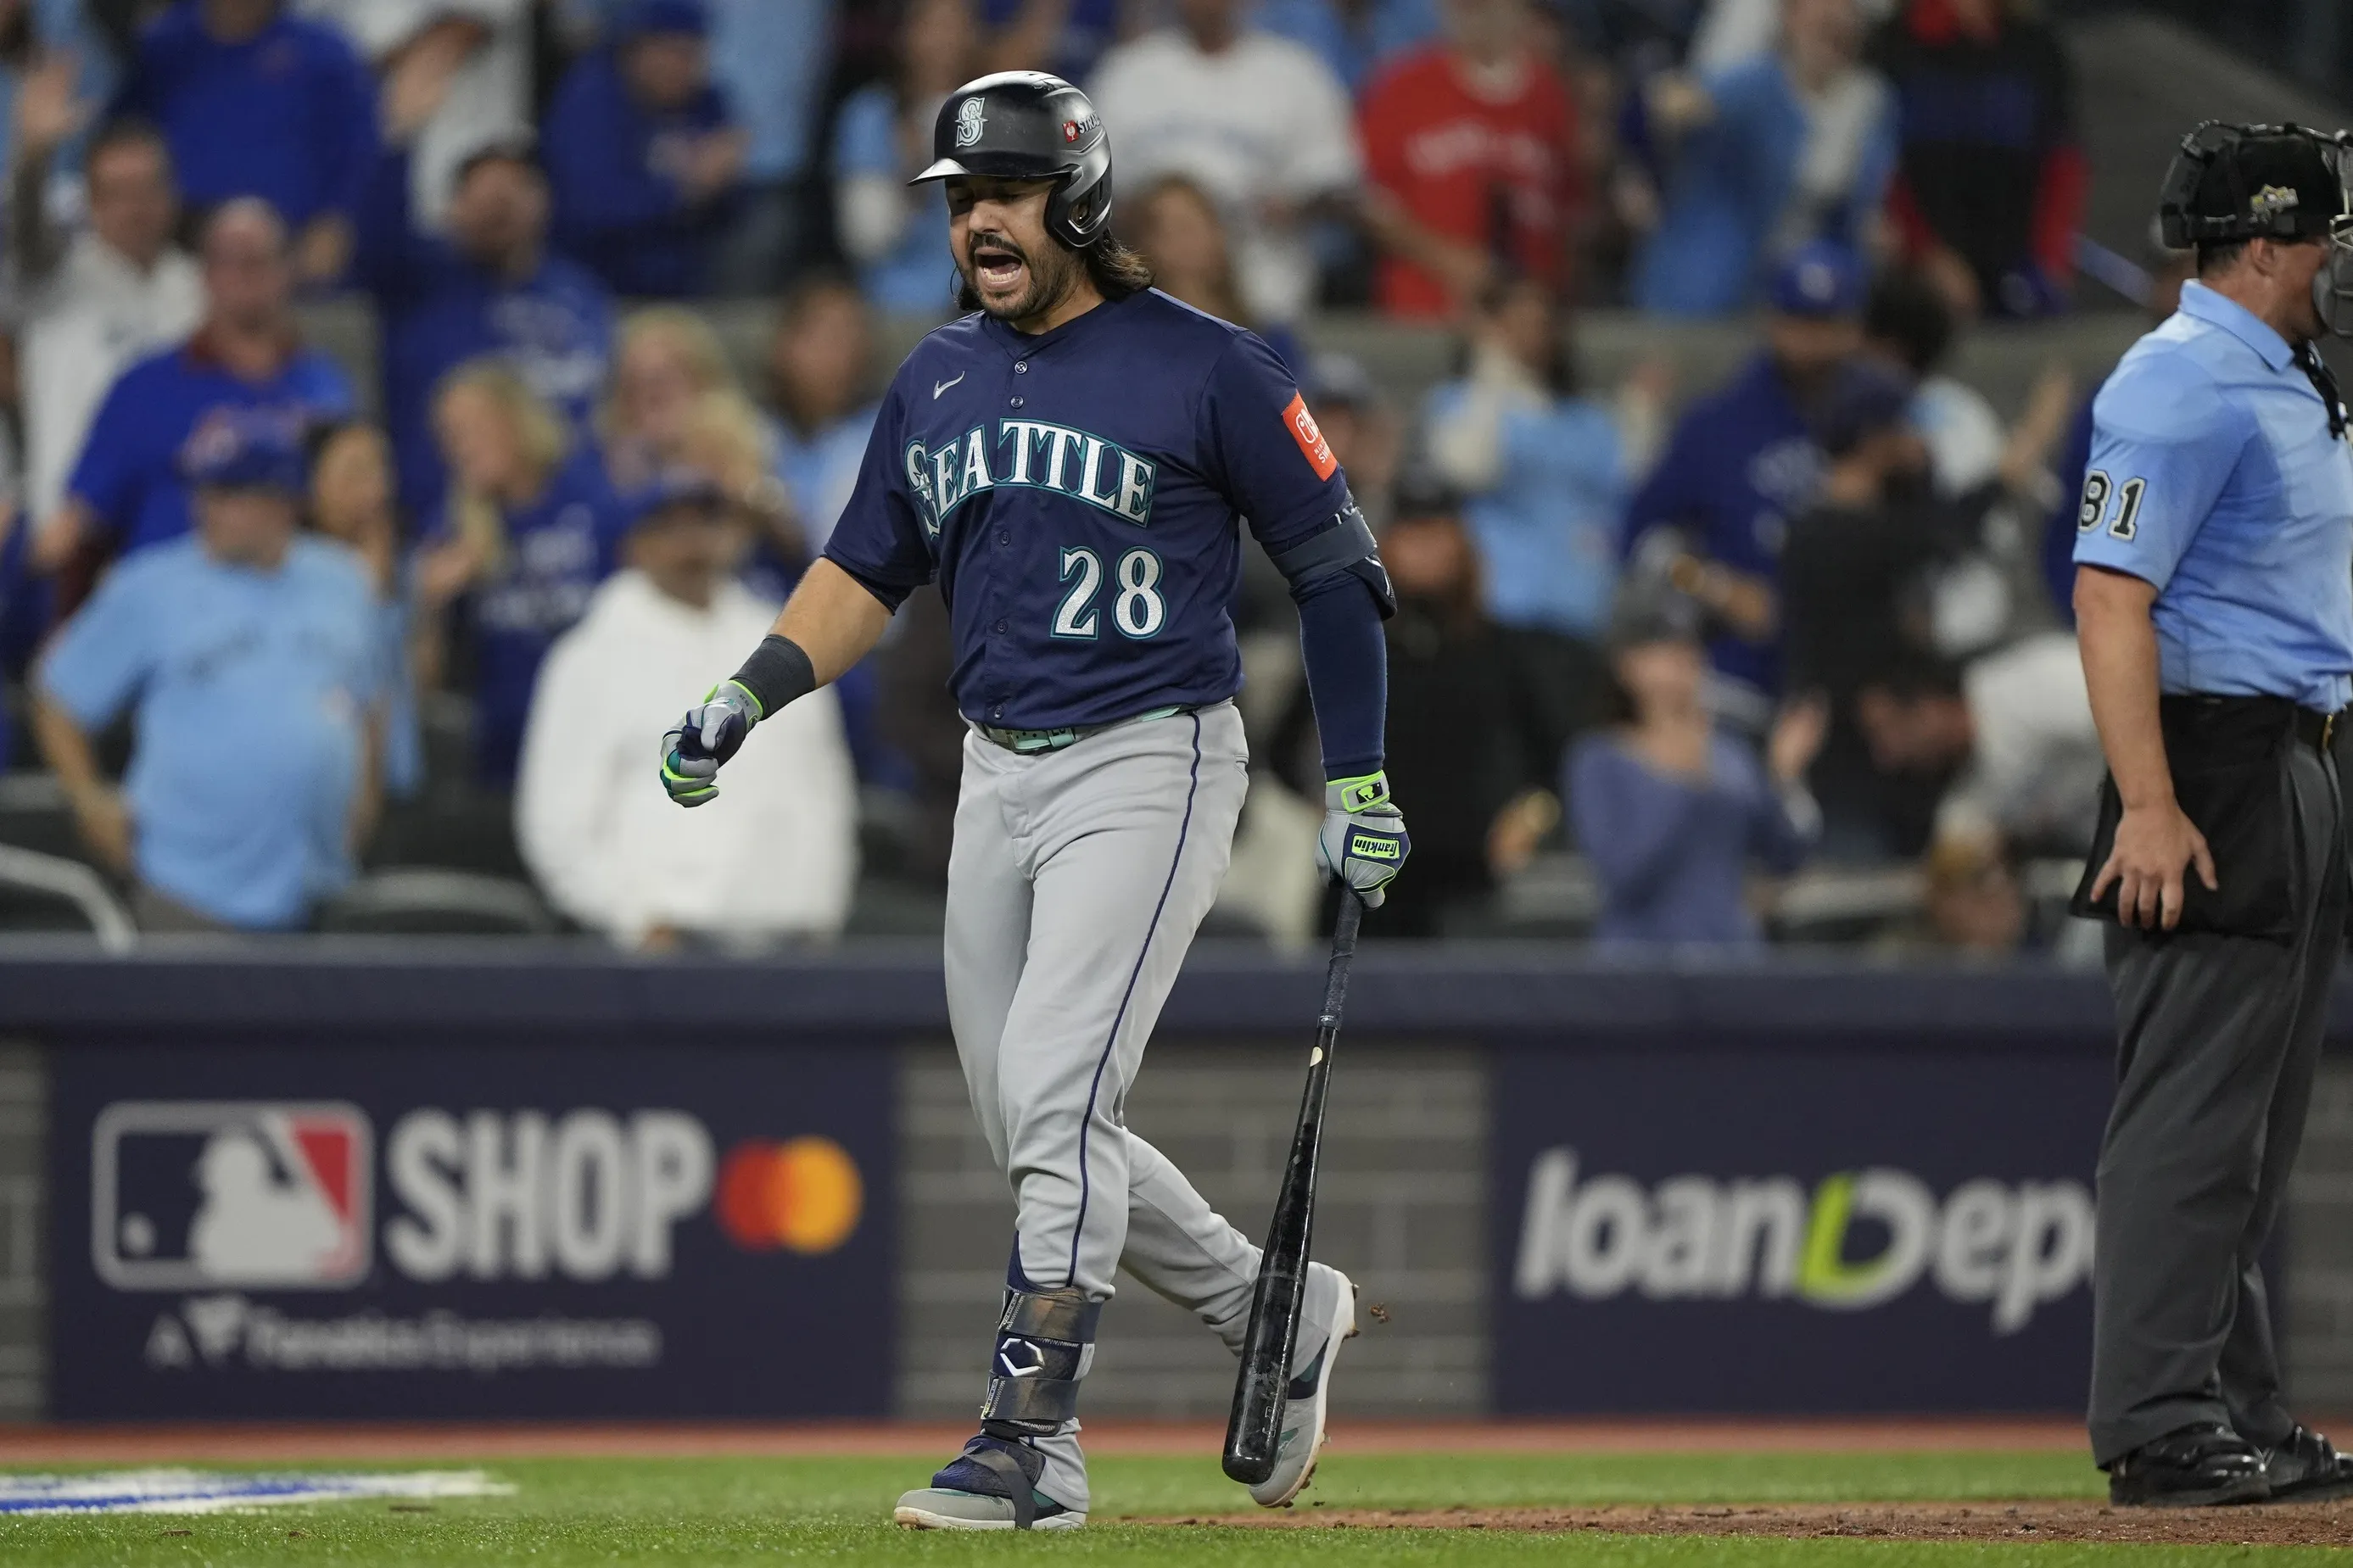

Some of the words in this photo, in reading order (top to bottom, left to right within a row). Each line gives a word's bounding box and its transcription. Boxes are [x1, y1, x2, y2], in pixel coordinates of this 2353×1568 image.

[904, 417, 1157, 541] SEATTLE
[2078, 469, 2148, 542] 81
[1050, 545, 1167, 639] 28
[386, 1107, 716, 1280] SHOP
